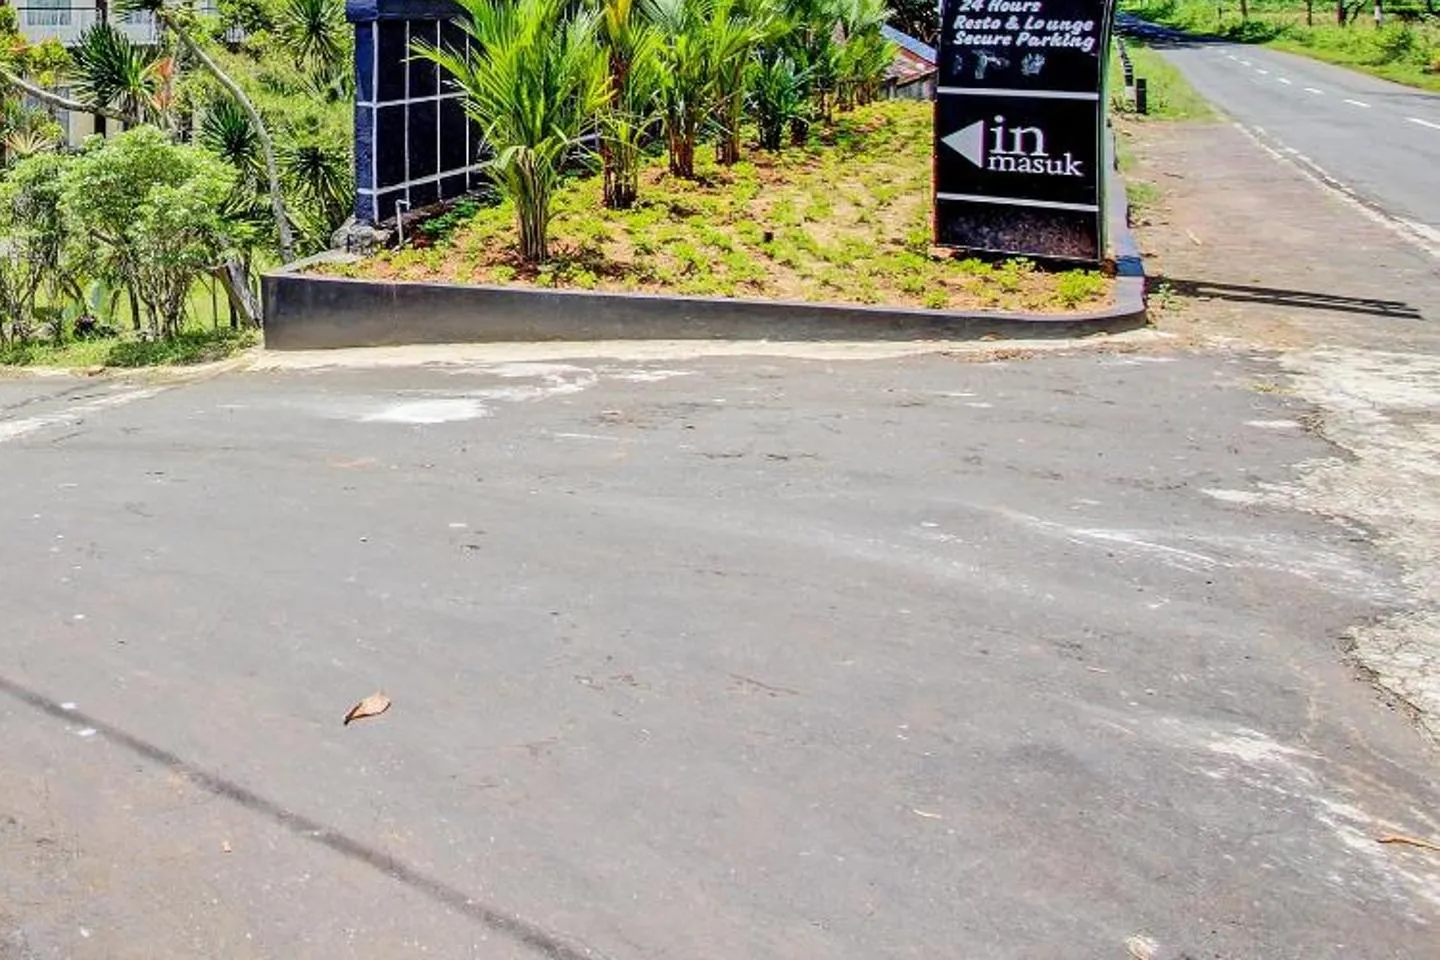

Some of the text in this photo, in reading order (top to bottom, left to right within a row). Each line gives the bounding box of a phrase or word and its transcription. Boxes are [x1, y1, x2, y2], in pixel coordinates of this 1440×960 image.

[953, 15, 1002, 30] Resto
[1005, 15, 1020, 30] &
[953, 31, 1096, 52] Secure Parking
[989, 115, 1049, 156] in
[988, 151, 1084, 177] masuk
